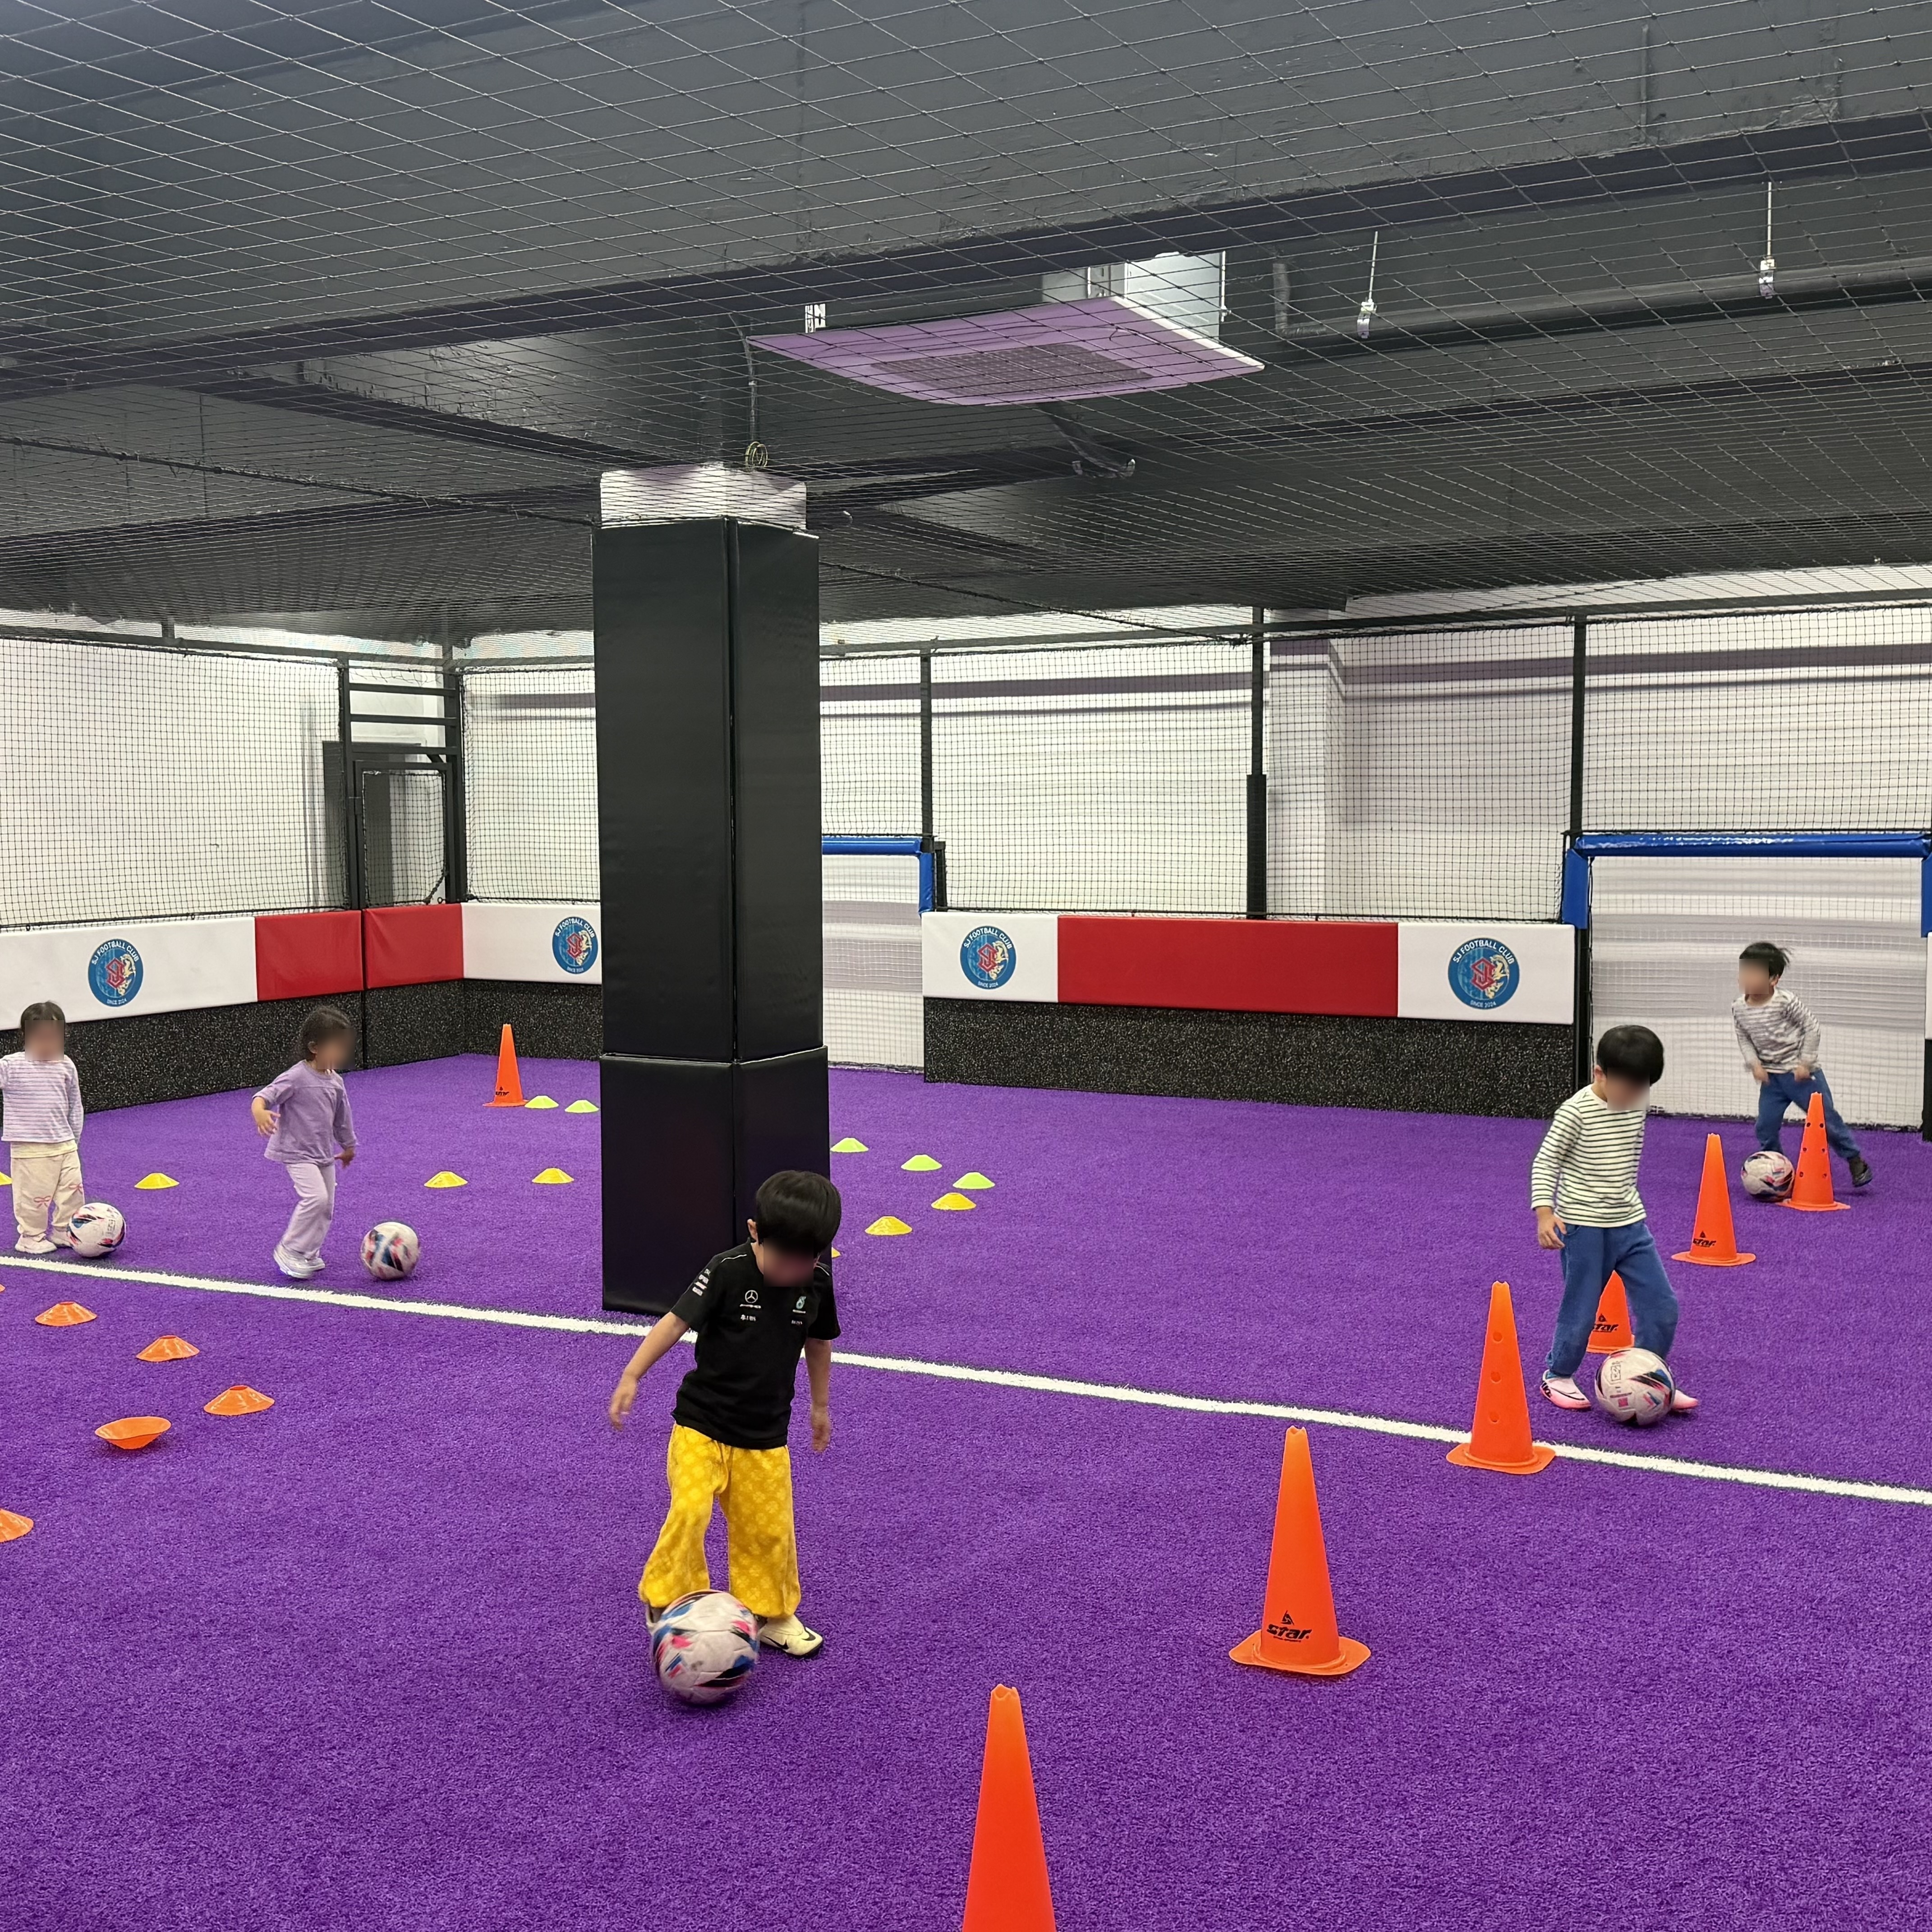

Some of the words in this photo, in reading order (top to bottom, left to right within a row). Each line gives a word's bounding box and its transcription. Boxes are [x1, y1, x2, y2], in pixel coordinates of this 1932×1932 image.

[555, 929, 561, 937] SJ
[560, 918, 583, 930] FOOTBALL
[584, 924, 595, 938] CLUB
[964, 939, 970, 948] SJ
[969, 927, 998, 941] FOOTBALL
[999, 933, 1012, 949] CLUB
[97, 941, 125, 957] FOOTBALL
[126, 945, 139, 961] CLUB
[1453, 952, 1462, 963] SJ
[1460, 939, 1497, 954] FOOTBALL
[1498, 946, 1515, 964] CLUB
